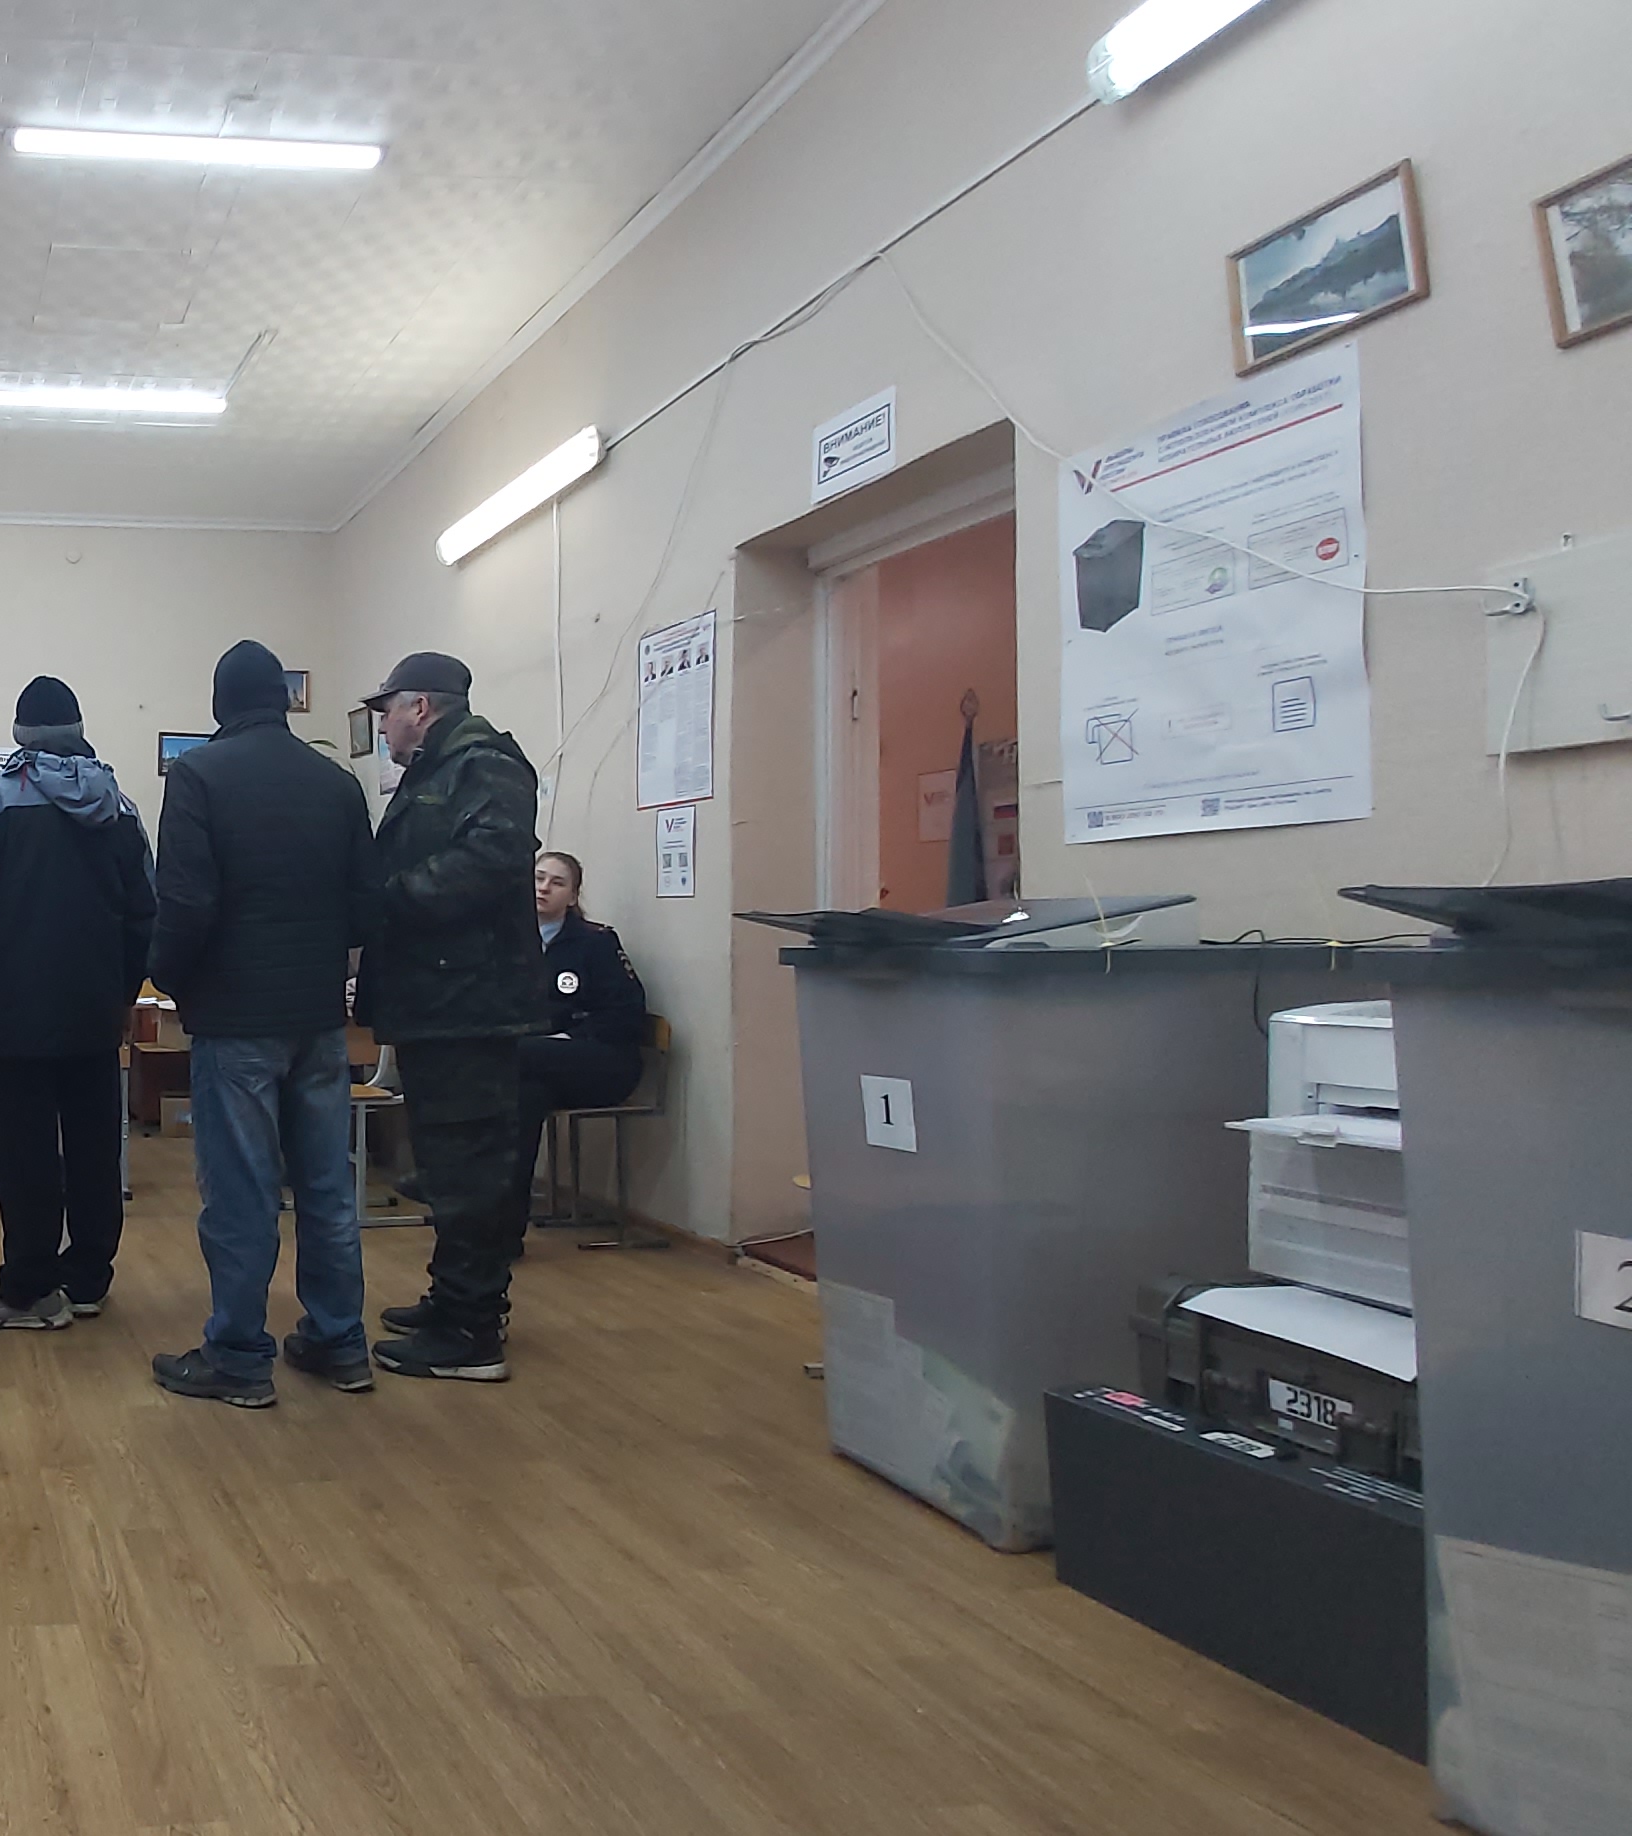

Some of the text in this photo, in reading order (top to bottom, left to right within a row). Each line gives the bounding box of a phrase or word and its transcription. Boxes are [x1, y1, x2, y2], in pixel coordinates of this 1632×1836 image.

[823, 410, 886, 455] ВНИМАНИЕ!
[880, 1093, 895, 1126] 1
[1285, 1386, 1337, 1427] 2318
